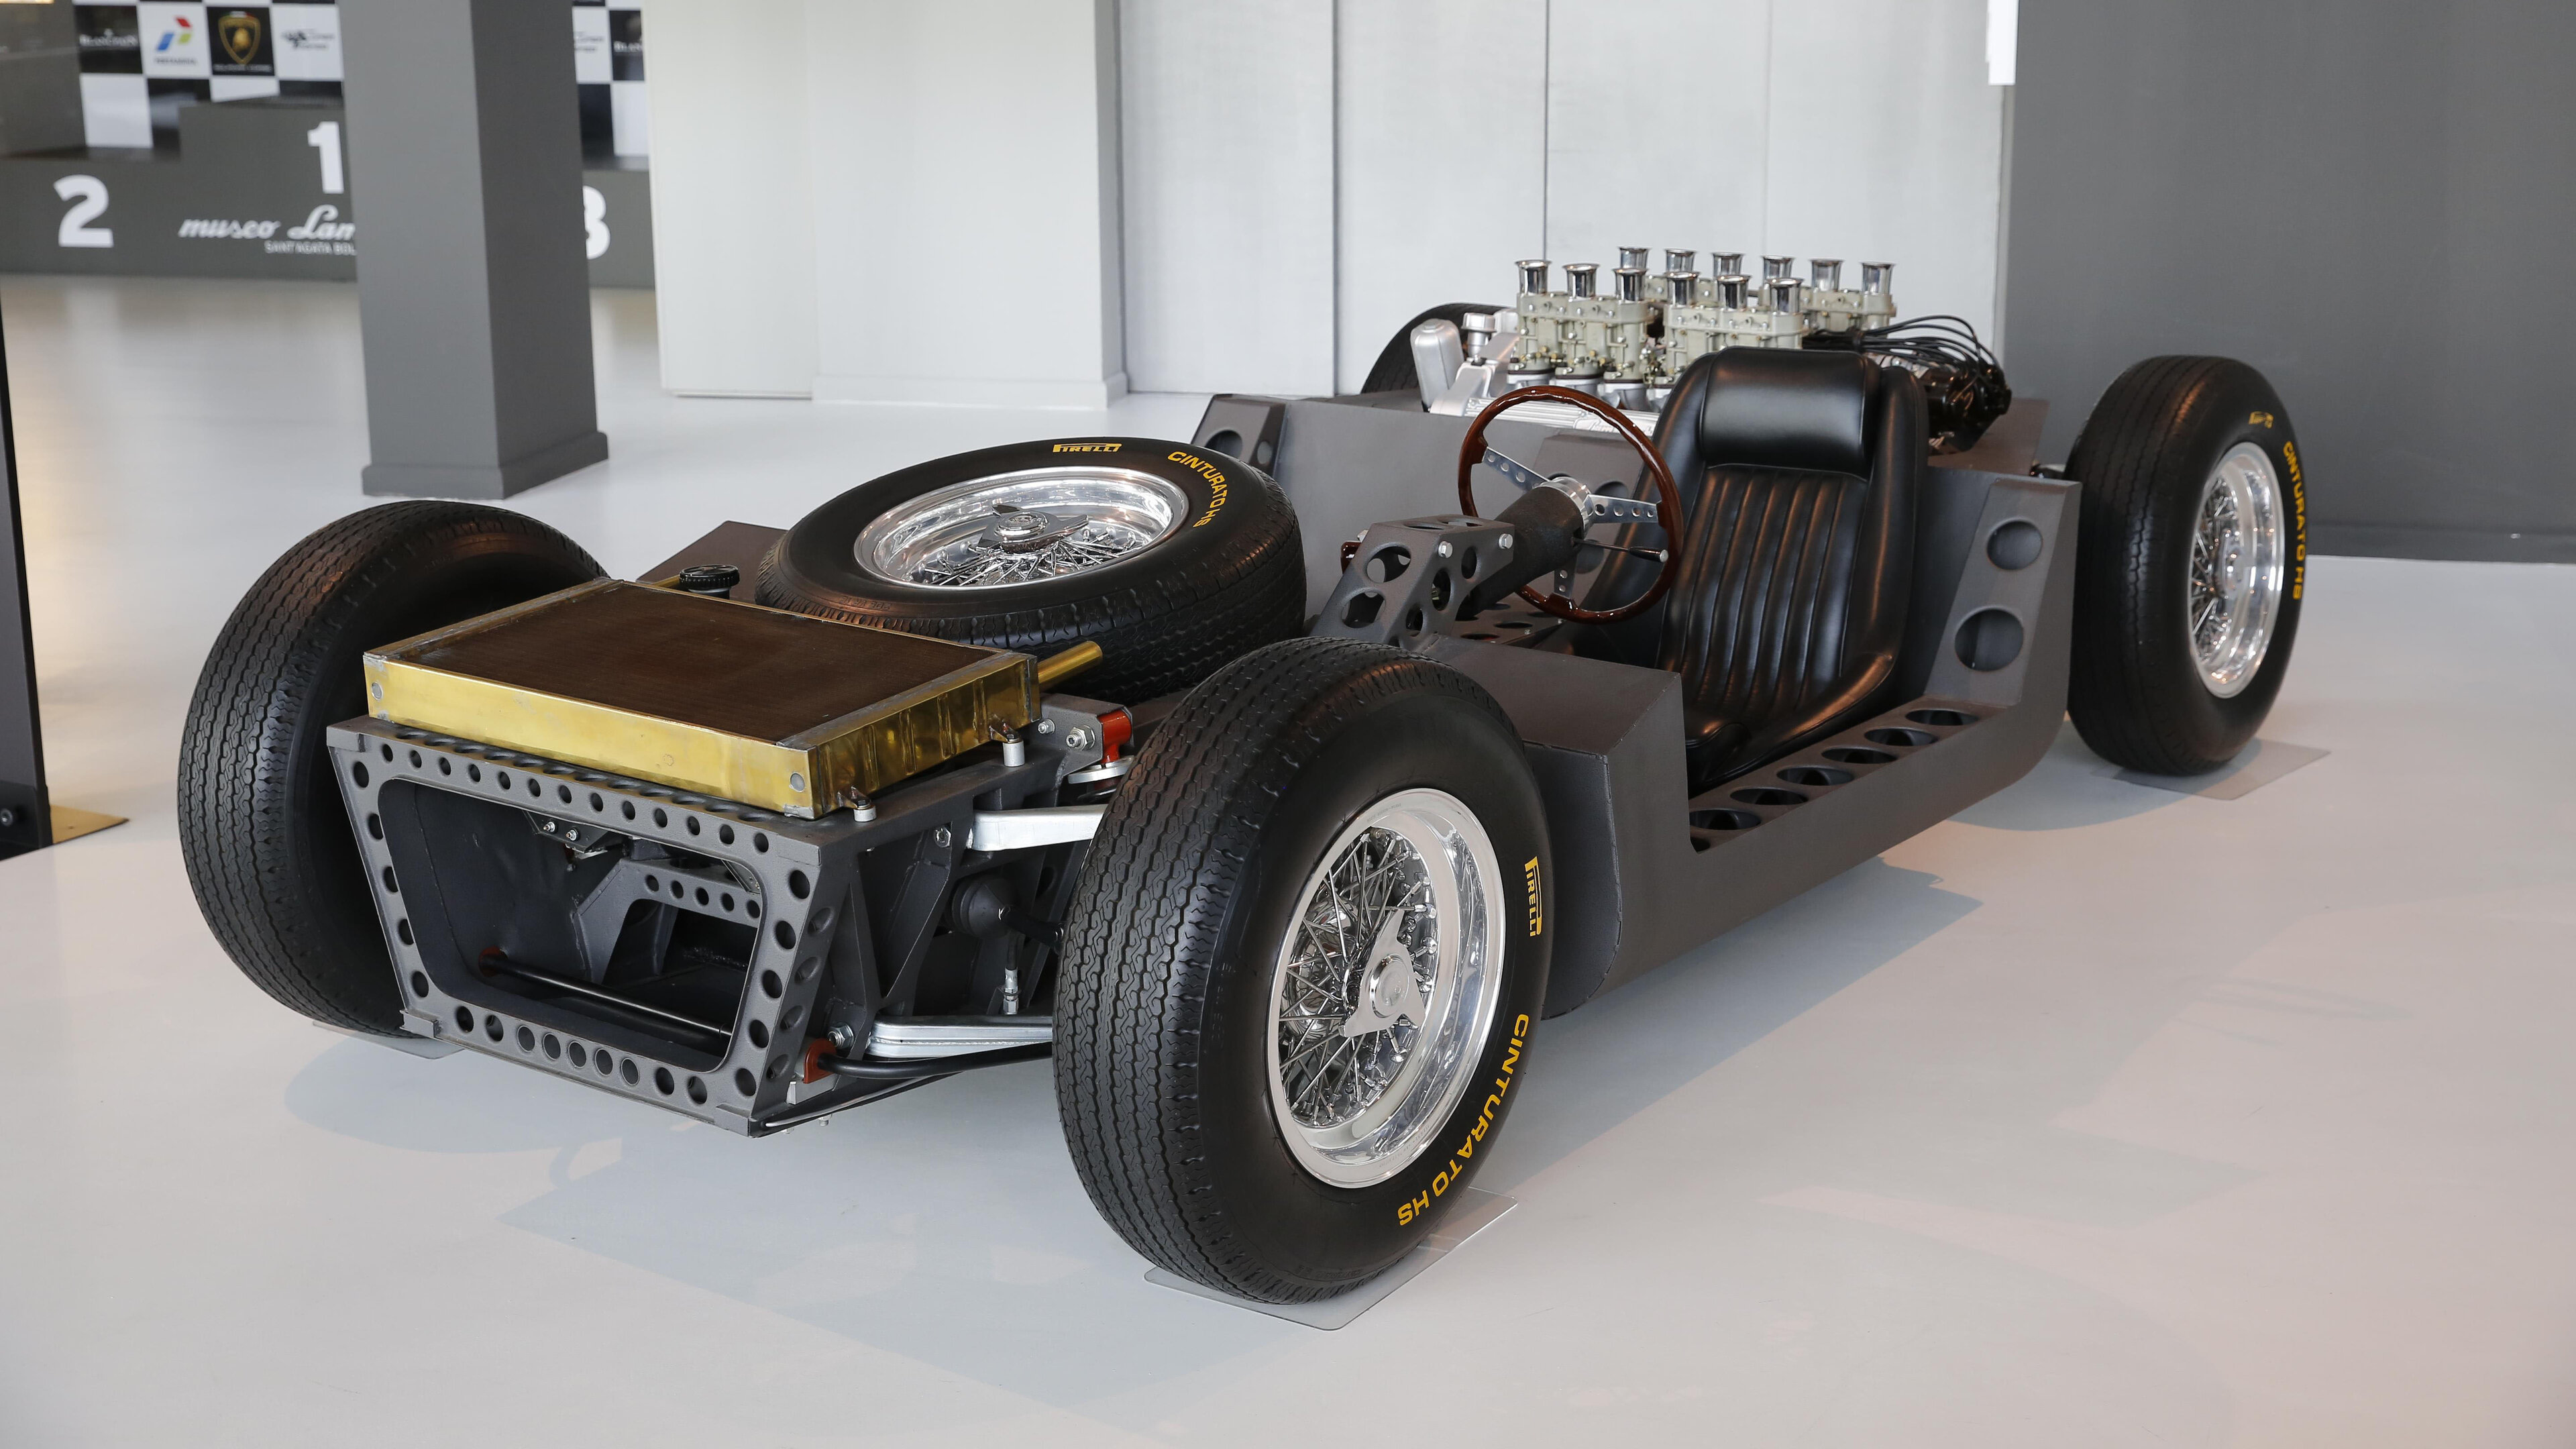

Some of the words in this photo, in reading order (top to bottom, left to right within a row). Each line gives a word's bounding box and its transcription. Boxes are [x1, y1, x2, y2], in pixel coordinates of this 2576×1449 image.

[307, 121, 343, 194] 1
[54, 175, 113, 248] 2
[178, 219, 280, 239] museo
[1053, 443, 1122, 453] PIRELLI
[1167, 451, 1228, 508] CINTURATO
[2283, 441, 2306, 561] CINTURATO
[1193, 508, 1220, 528] HS
[2293, 567, 2304, 600] HS
[1524, 856, 1542, 937] PIRELLI
[1432, 1014, 1529, 1197] CINTURATO
[1397, 1190, 1430, 1226] HS
